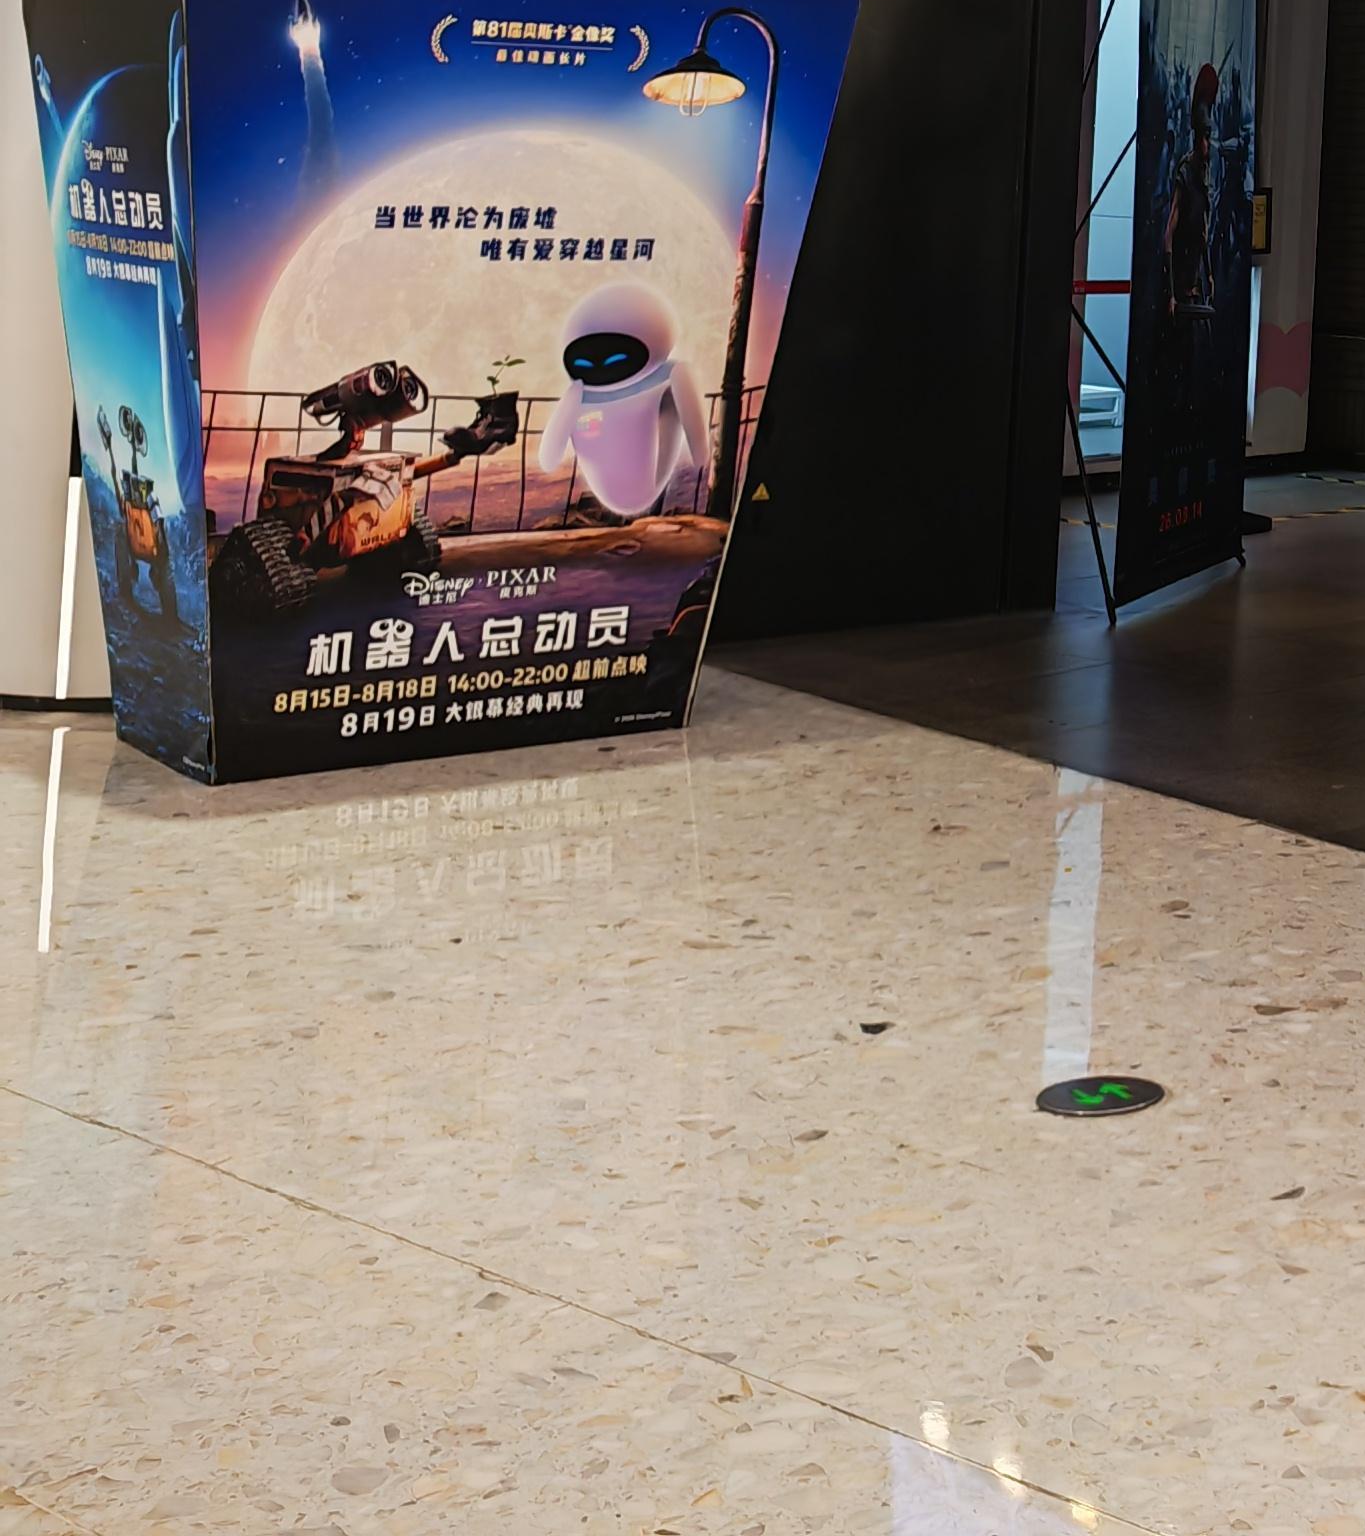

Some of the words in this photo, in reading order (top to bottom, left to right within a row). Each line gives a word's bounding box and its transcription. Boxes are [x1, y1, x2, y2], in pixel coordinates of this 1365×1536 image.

[105, 146, 129, 162] PIXAR
[68, 177, 164, 231] 机器人总动员
[374, 205, 558, 230] 当世界沦为废墟
[480, 238, 655, 262] 唯有爱穿越星河
[85, 256, 112, 278] 8月19日
[486, 566, 557, 589] PIXAR
[418, 591, 458, 606] 迪士尼
[499, 584, 538, 599] 皮克斯
[306, 605, 630, 677] 机器人总动员
[274, 674, 438, 713] 8月15日-8月18日
[447, 663, 569, 693] 14:00-22:00
[571, 654, 648, 683] 超前点映
[340, 703, 436, 737] 8月19日
[444, 688, 585, 724] 大银幕经典再现
